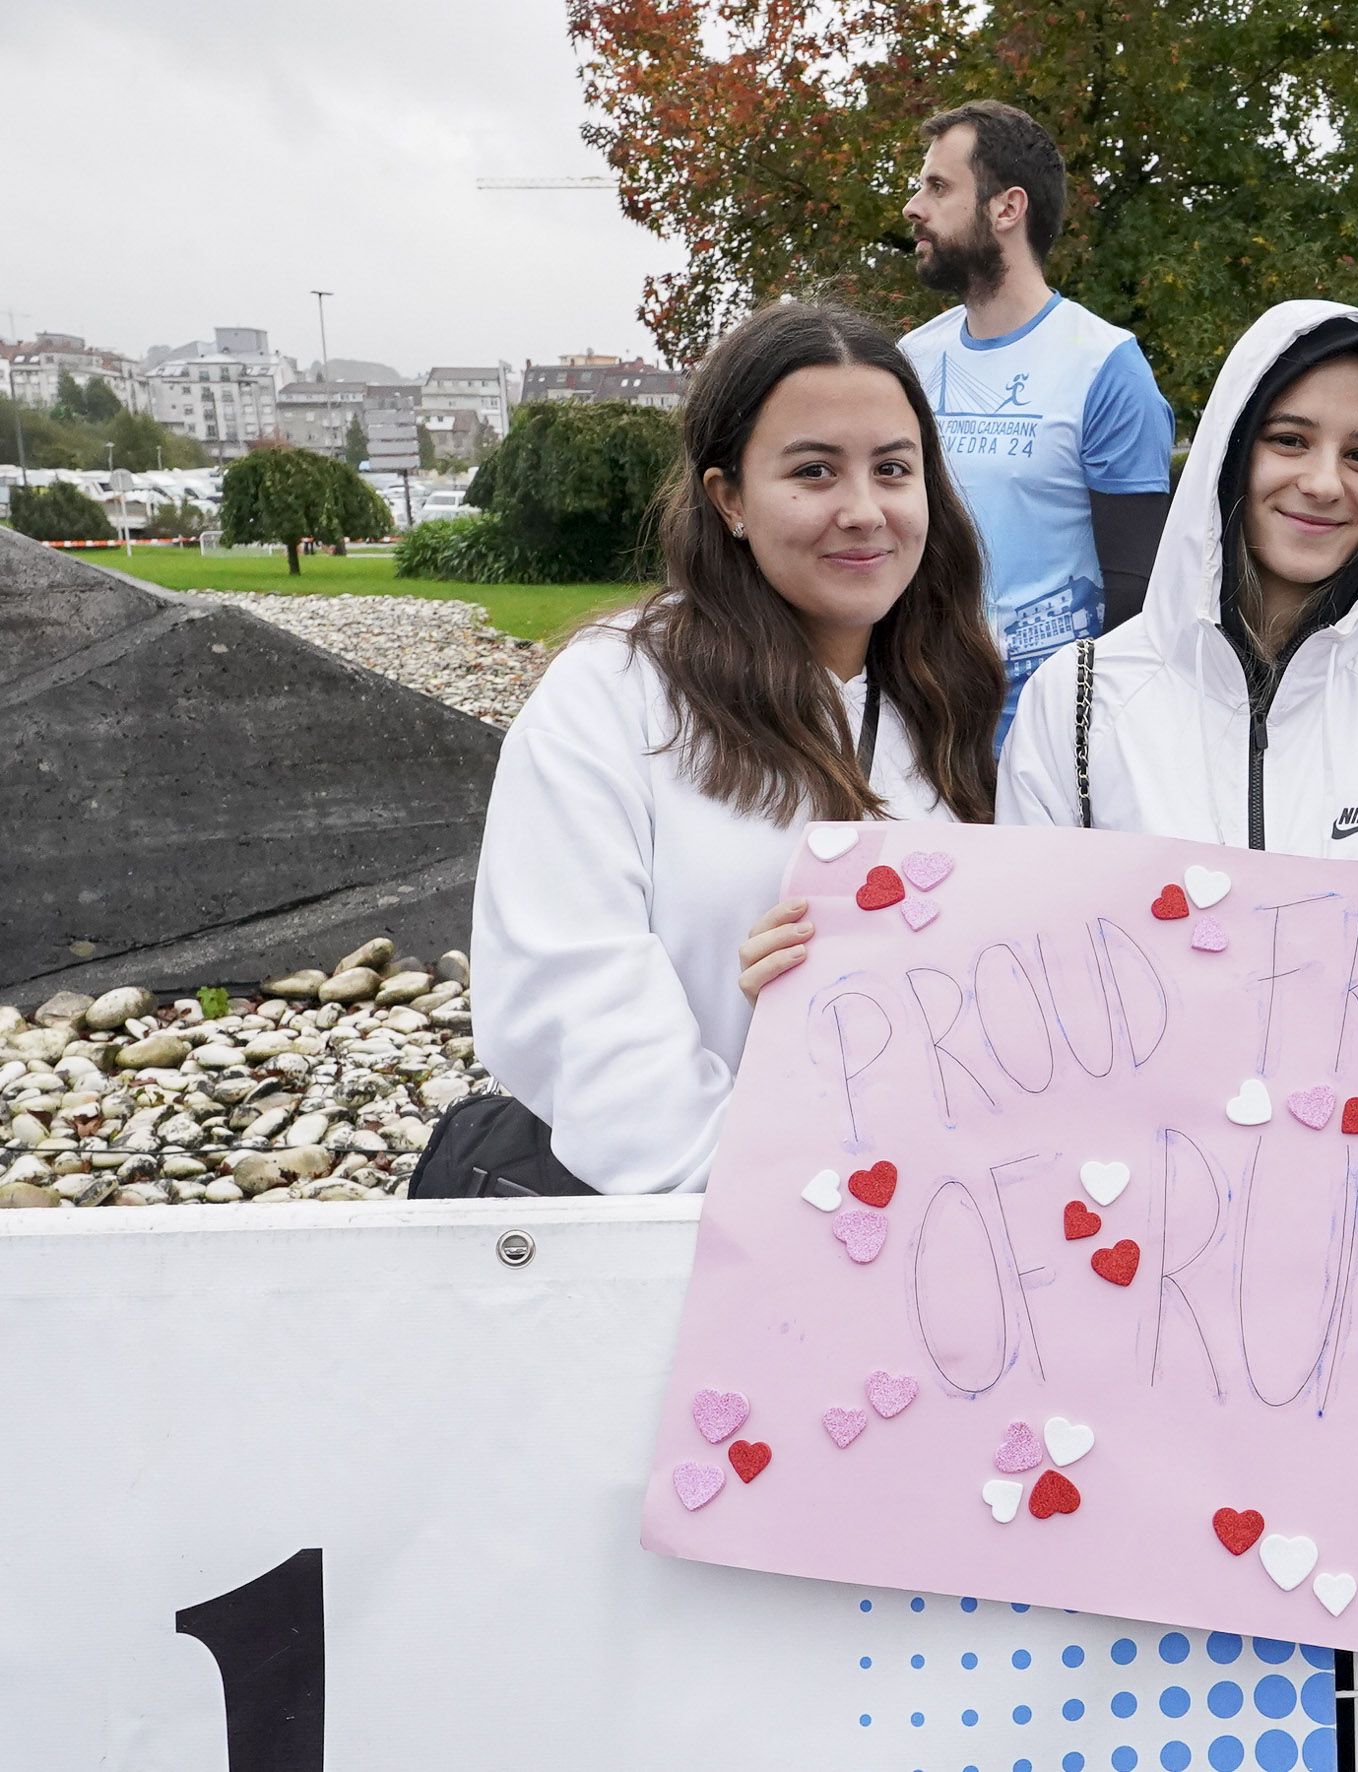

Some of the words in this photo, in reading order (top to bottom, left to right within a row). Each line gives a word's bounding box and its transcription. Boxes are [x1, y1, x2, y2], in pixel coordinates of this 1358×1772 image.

[942, 436, 997, 454] VEDRA
[1007, 437, 1034, 458] 24
[945, 420, 977, 435] FONDO
[978, 420, 1038, 438] CAIXABANK
[812, 917, 1170, 1145] PROUD
[911, 1153, 1048, 1396] OF
